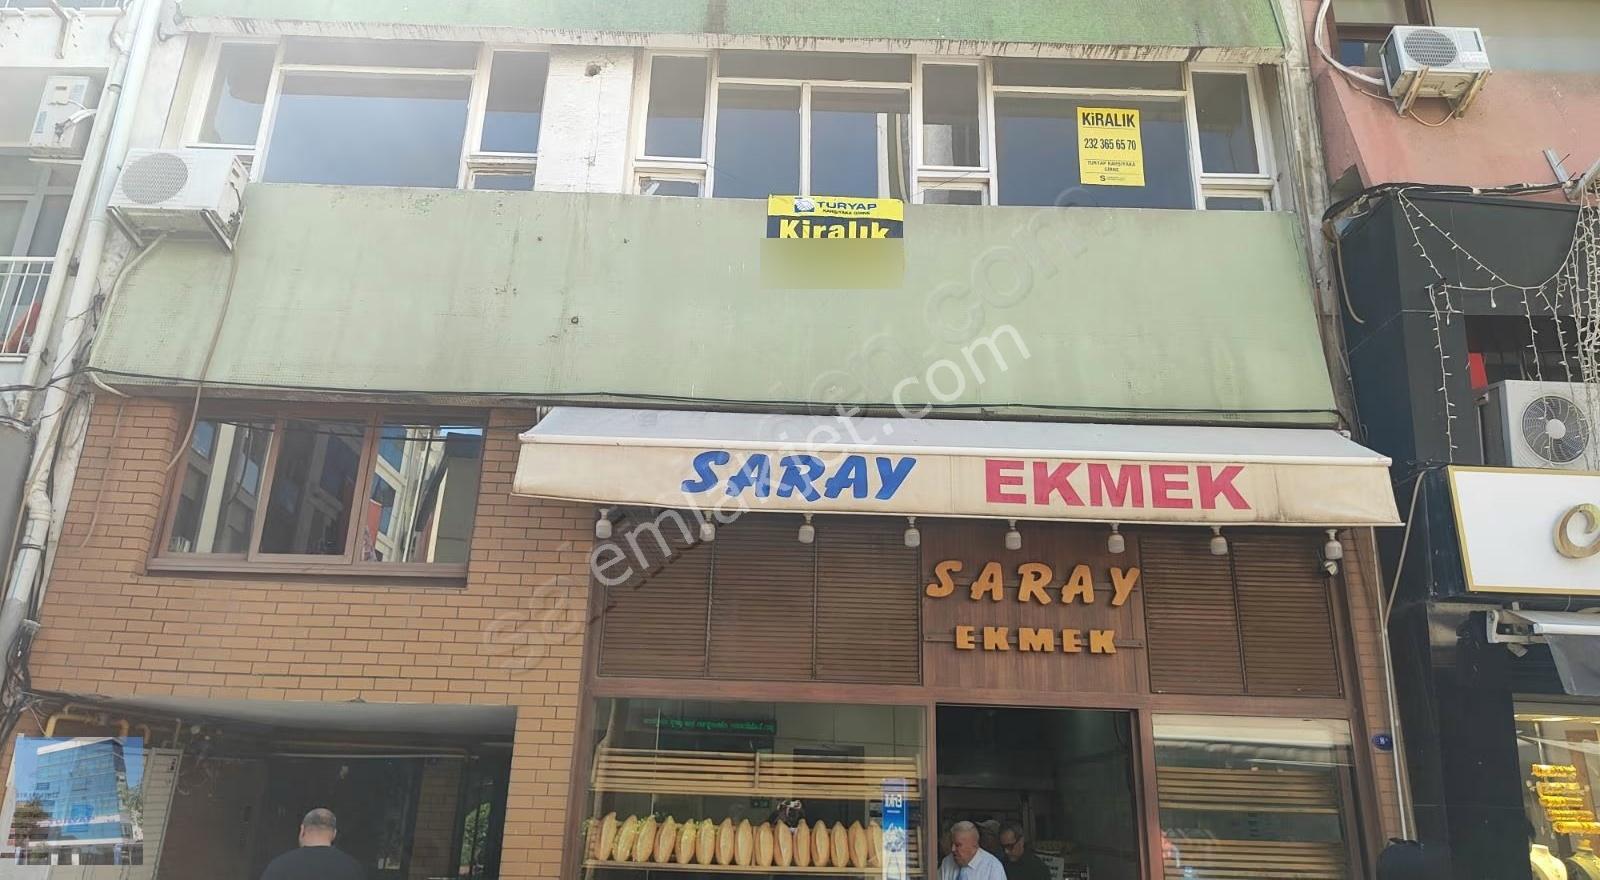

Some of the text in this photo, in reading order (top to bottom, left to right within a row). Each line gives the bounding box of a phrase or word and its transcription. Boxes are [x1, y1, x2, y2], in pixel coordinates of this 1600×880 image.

[1084, 138, 1137, 151] 232 365 65 70
[816, 200, 878, 211] TURYAP
[680, 449, 1253, 510] SARAY EKMEK
[925, 559, 1141, 606] SARAY
[954, 624, 1118, 655] EKMEK
